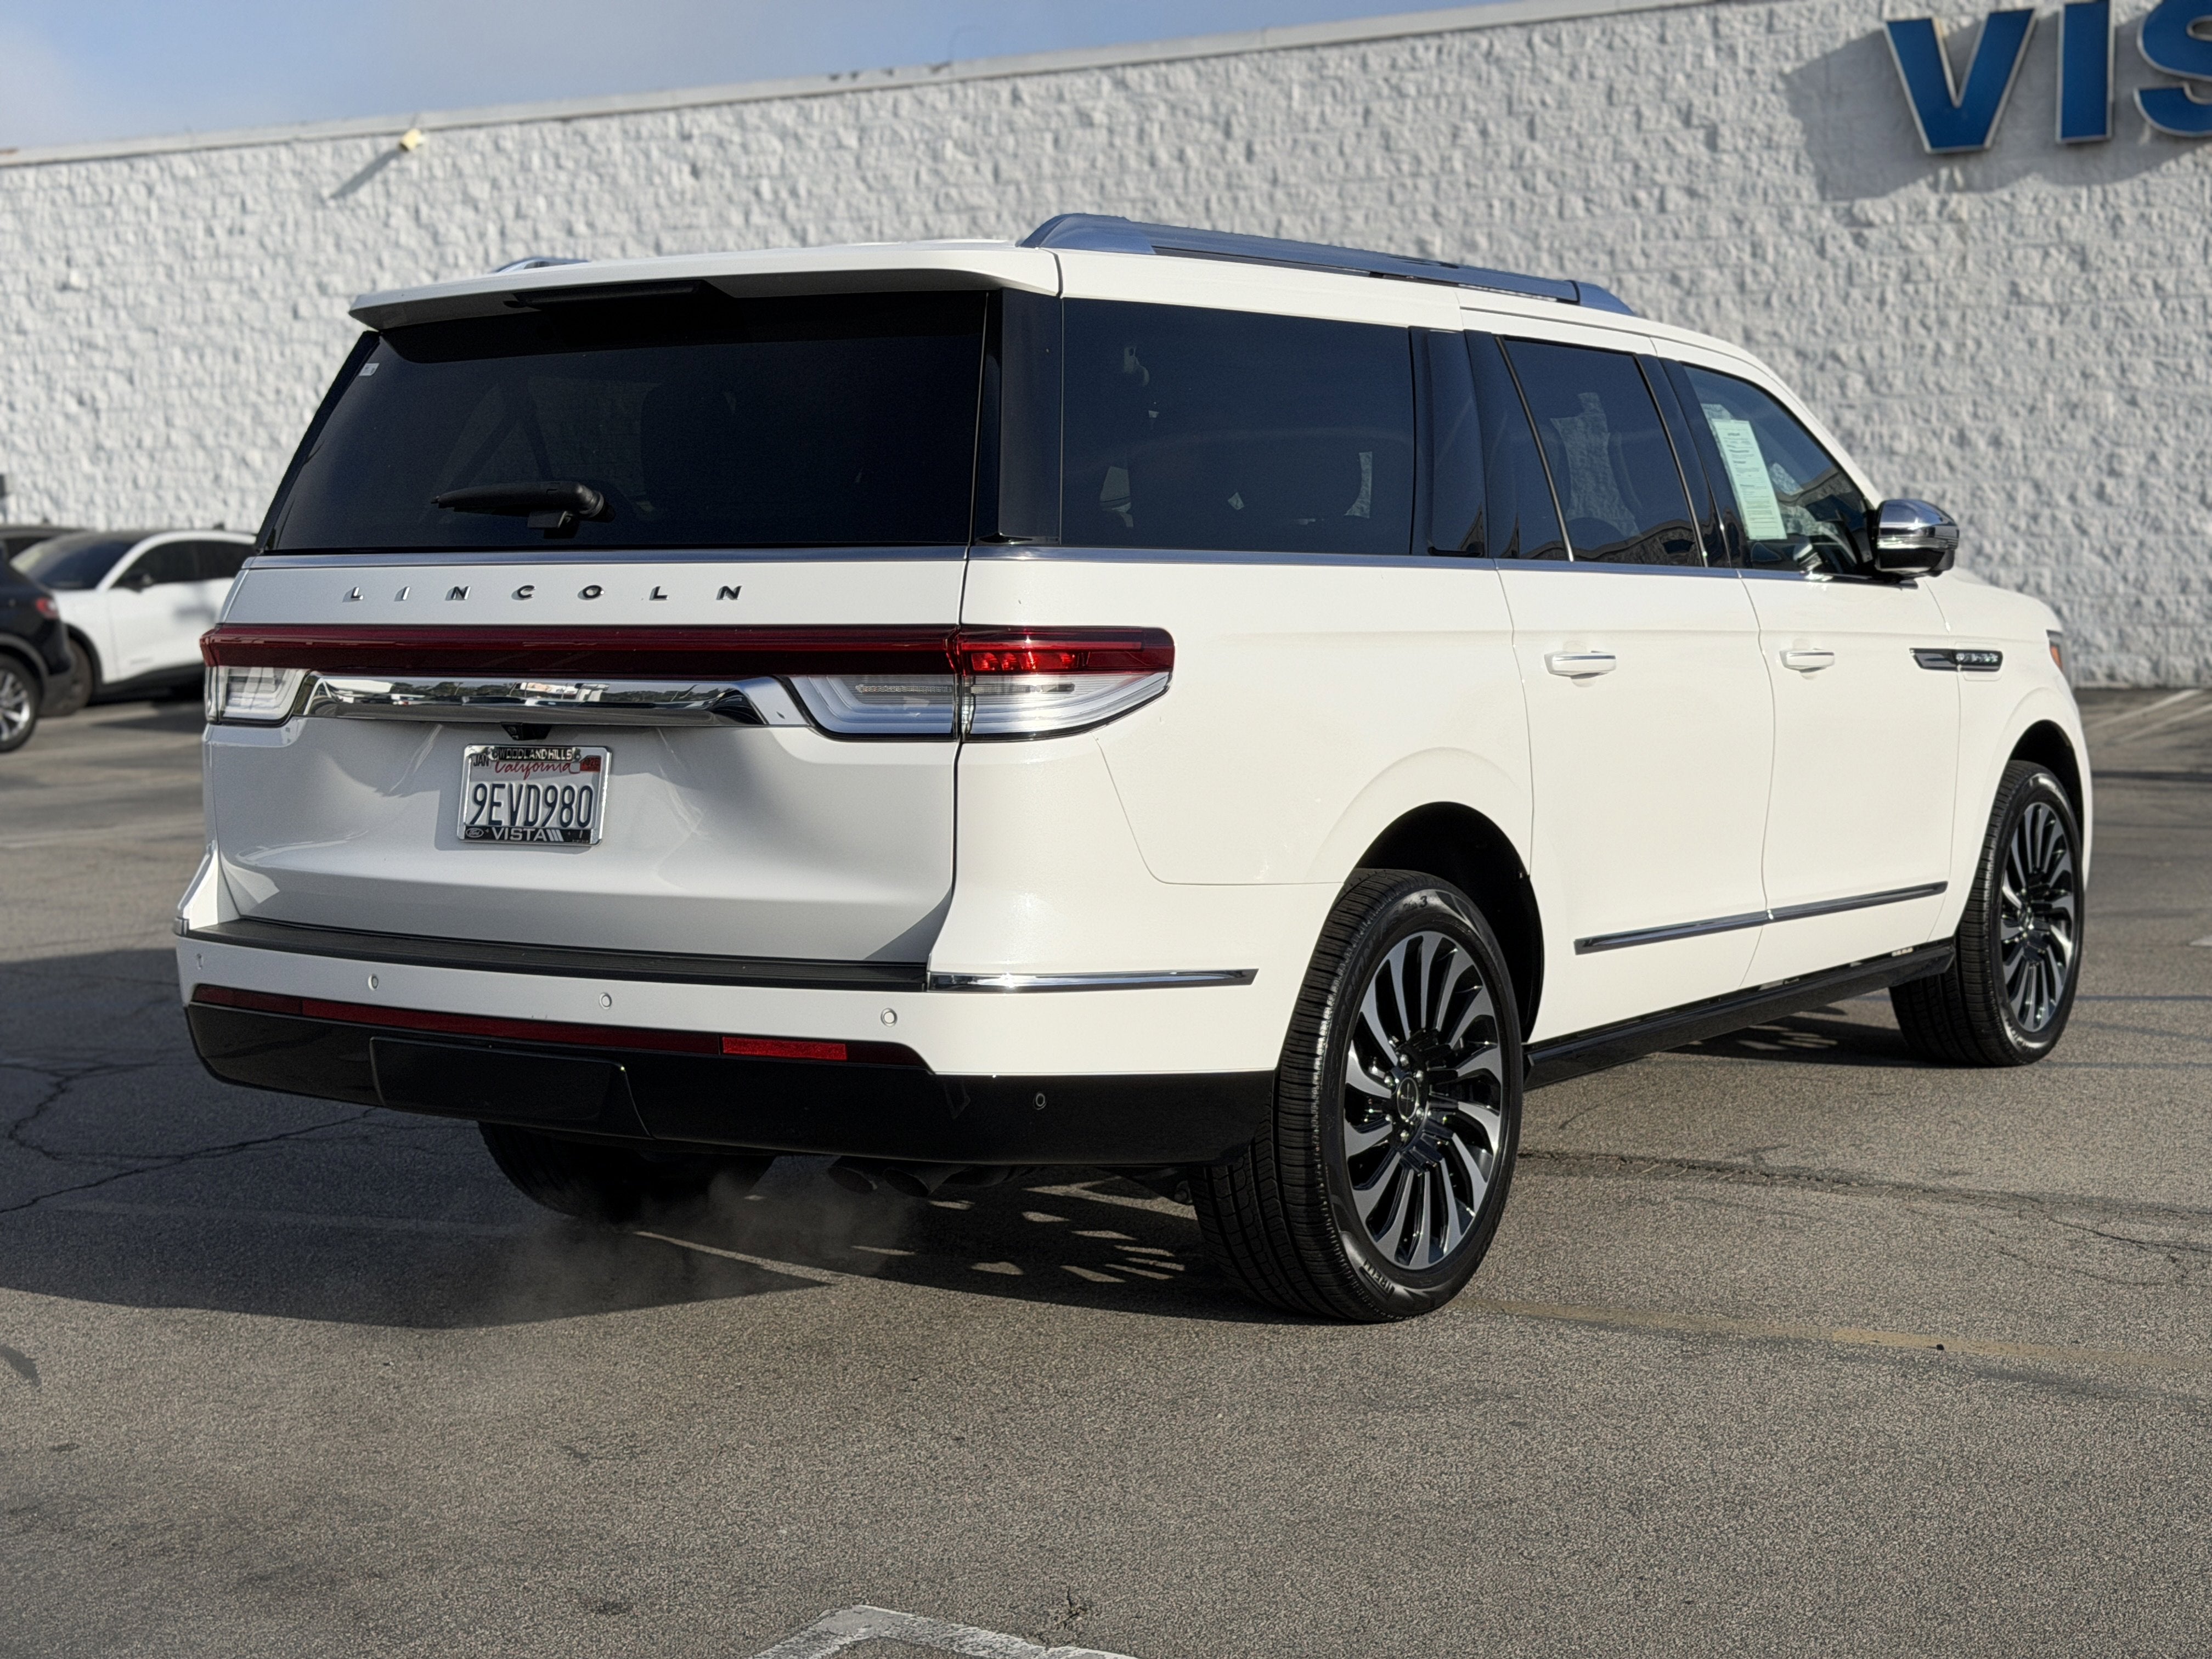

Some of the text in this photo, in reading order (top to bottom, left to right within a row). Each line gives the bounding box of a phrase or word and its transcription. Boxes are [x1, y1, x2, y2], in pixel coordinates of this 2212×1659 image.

[348, 584, 742, 601] LINCOLN
[472, 755, 490, 767] JAN
[498, 748, 572, 760] WOODLAND HILLS
[495, 760, 580, 780] California
[470, 783, 594, 828] 9EVD980
[492, 827, 548, 842] VISTA
[1359, 1258, 1395, 1300] PIRELLI
